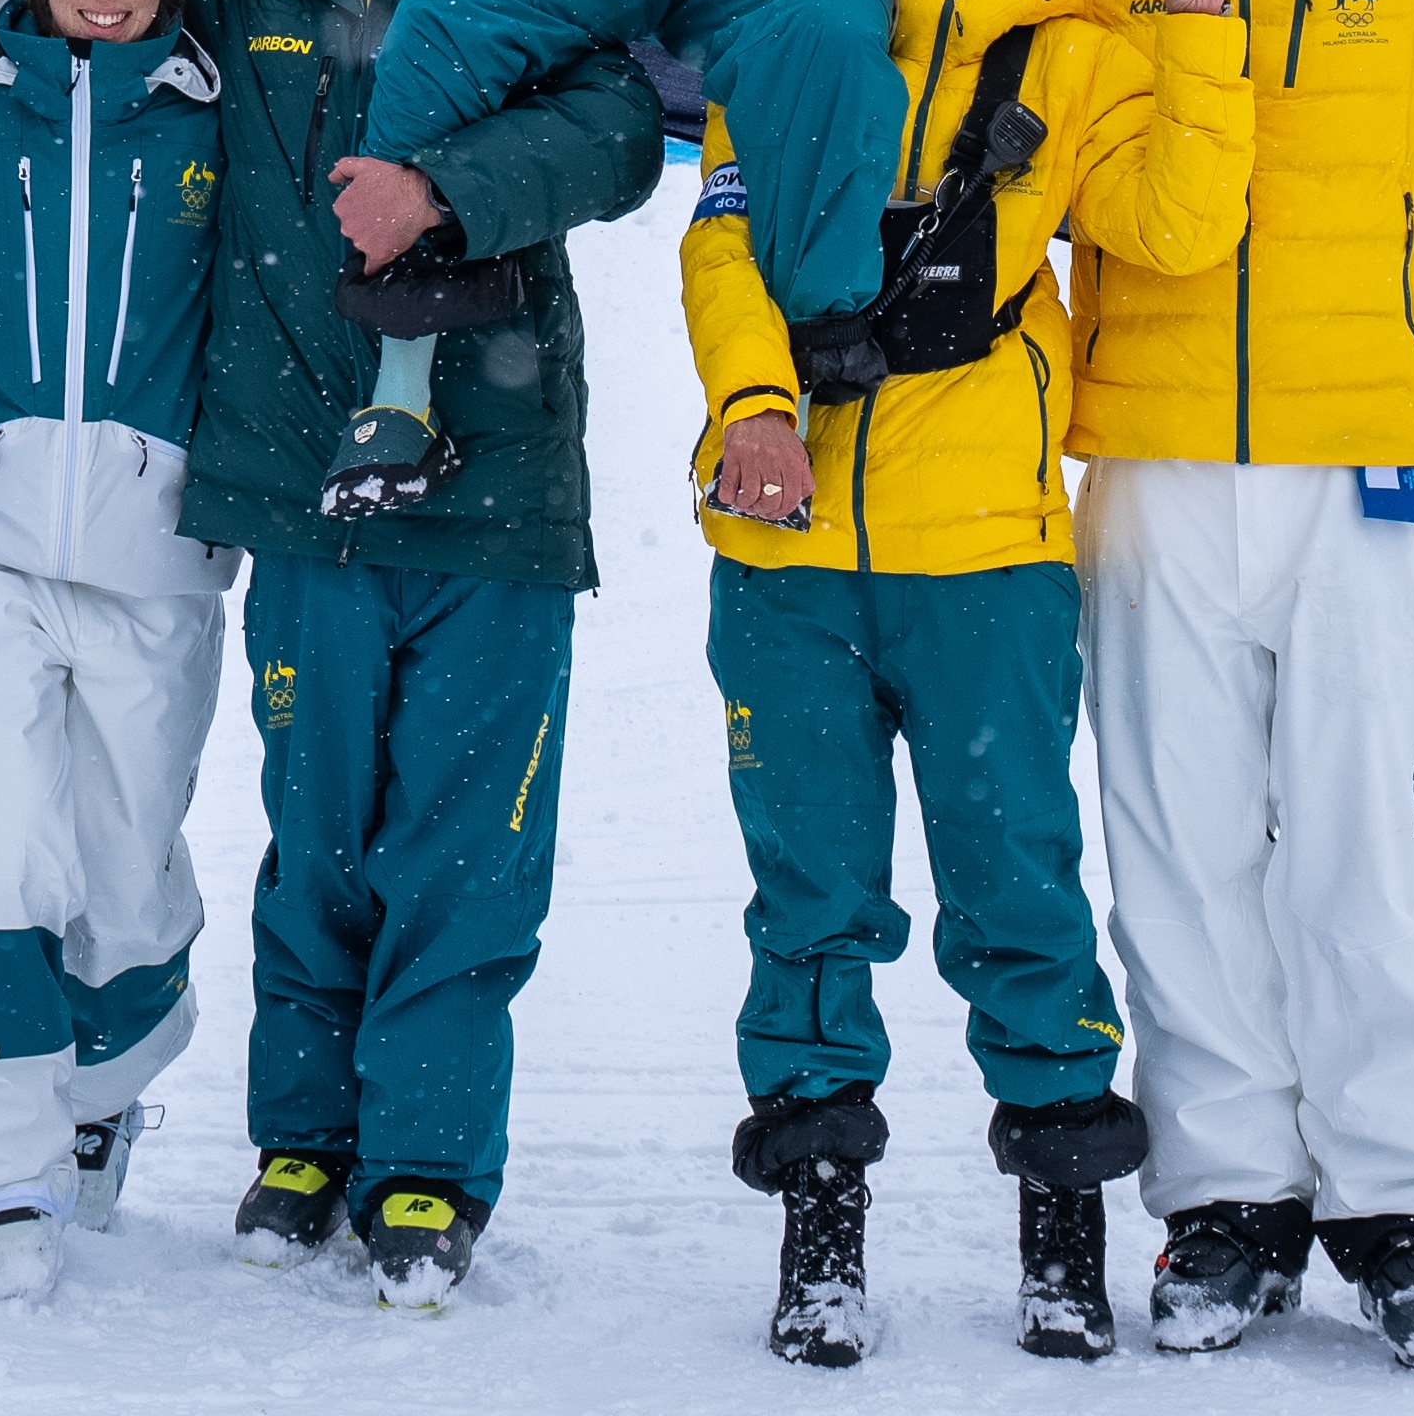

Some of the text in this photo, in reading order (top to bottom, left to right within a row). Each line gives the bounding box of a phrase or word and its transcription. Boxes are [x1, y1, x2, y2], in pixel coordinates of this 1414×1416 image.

[1337, 31, 1377, 39] AUSTRALIA
[248, 35, 314, 55] KARBON
[715, 196, 747, 210] FOR
[509, 712, 550, 833] KARBON
